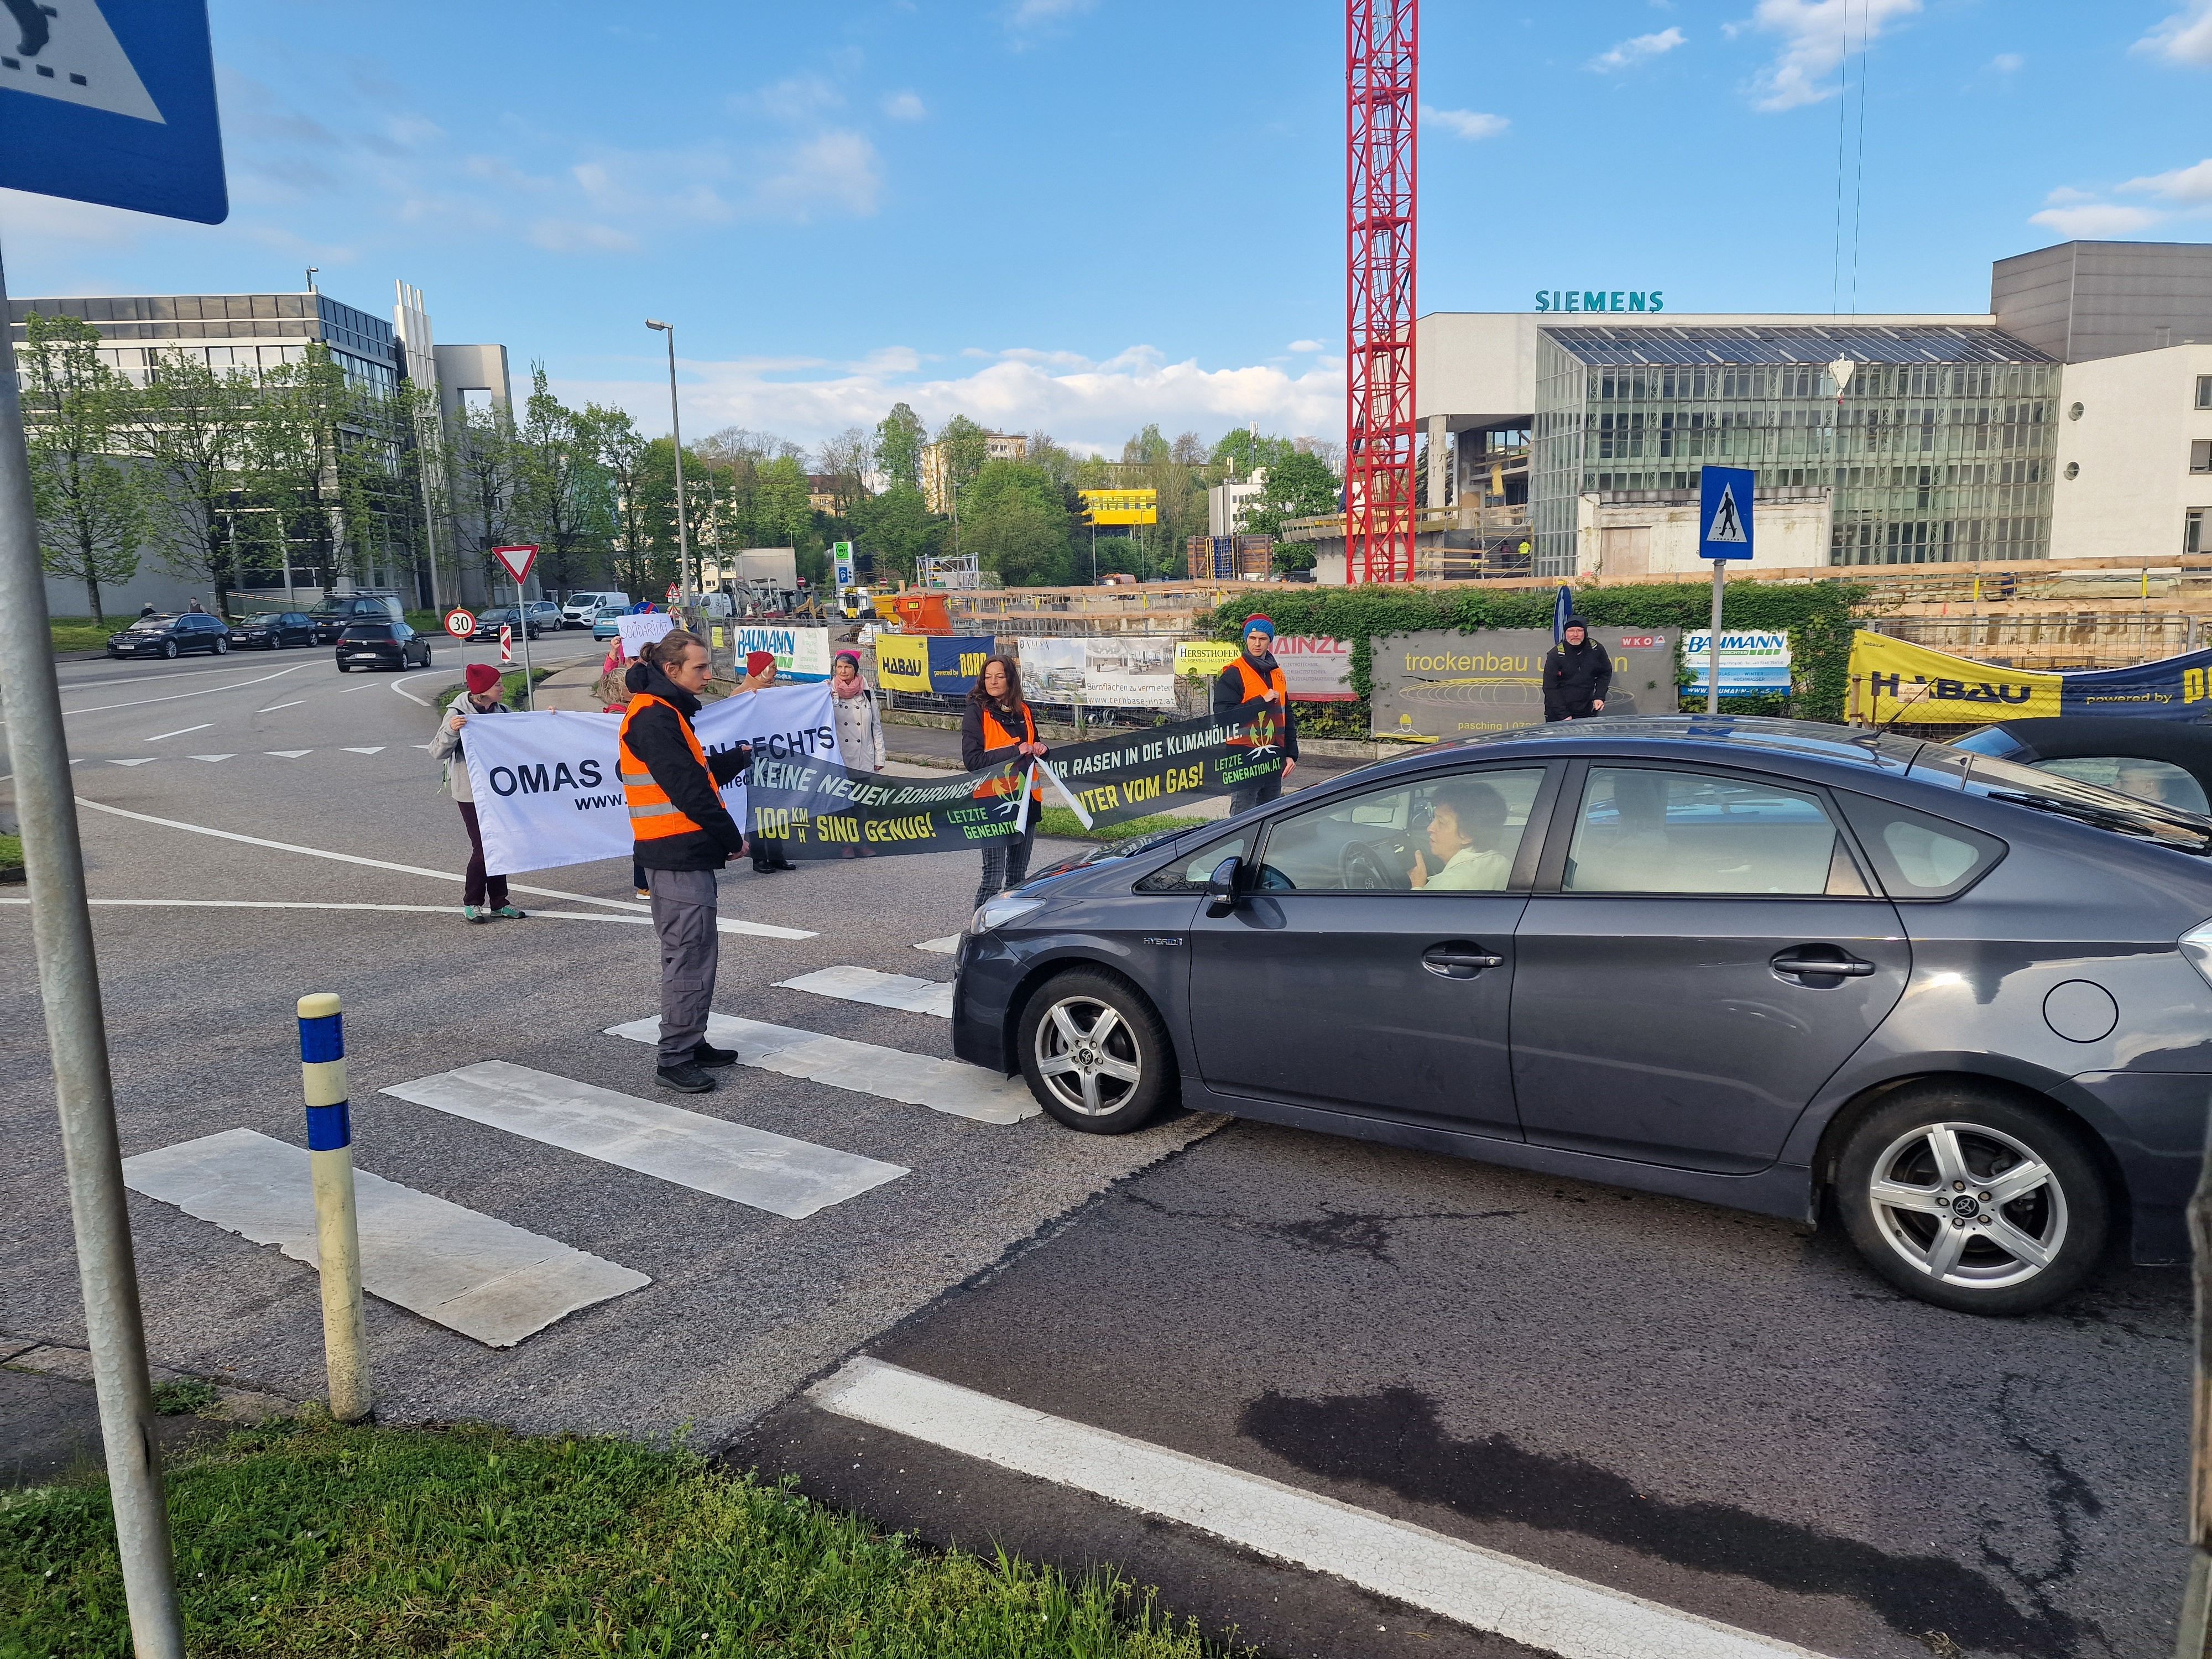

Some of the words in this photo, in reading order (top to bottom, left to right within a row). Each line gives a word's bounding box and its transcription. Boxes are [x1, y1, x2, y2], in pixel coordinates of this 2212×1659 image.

[1536, 290, 1663, 311] SIEMENS
[452, 616, 469, 631] 30
[738, 629, 795, 658] BAUMANN
[1622, 637, 1652, 646] WKO
[1181, 648, 1239, 658] HERBSTHOFER
[1405, 651, 1528, 672] trockenbau
[882, 656, 921, 677] HABAU
[1087, 682, 1128, 691] Büroflächen
[1138, 684, 1173, 692] vermieten
[1088, 696, 1175, 705] www.techbase-linz.at
[2086, 692, 2151, 705] powered
[2154, 692, 2173, 705] by
[1458, 722, 1502, 731] pasching
[1073, 750, 1120, 776] RASEN
[1125, 746, 1138, 766] IN
[1142, 740, 1163, 762] DIE
[1167, 722, 1243, 757] KLIMAHÖLLE.
[1214, 753, 1243, 772] LETZTE
[1222, 757, 1281, 785] GENERATION.AT
[489, 759, 602, 797] OMAS
[753, 757, 817, 791] KEINE
[817, 774, 896, 807] NEUEN
[891, 771, 992, 805] BOHRUNGEN!
[1073, 784, 1120, 813] NTER
[1122, 774, 1160, 804] VOM
[1166, 761, 1204, 794] GAS!
[754, 806, 790, 840] 100
[791, 807, 808, 823] KM
[946, 807, 989, 825] LETZTE
[797, 828, 806, 843] H
[816, 815, 860, 843] SIND
[864, 811, 937, 842] GENUG!
[963, 820, 1020, 840] GENERATIO
